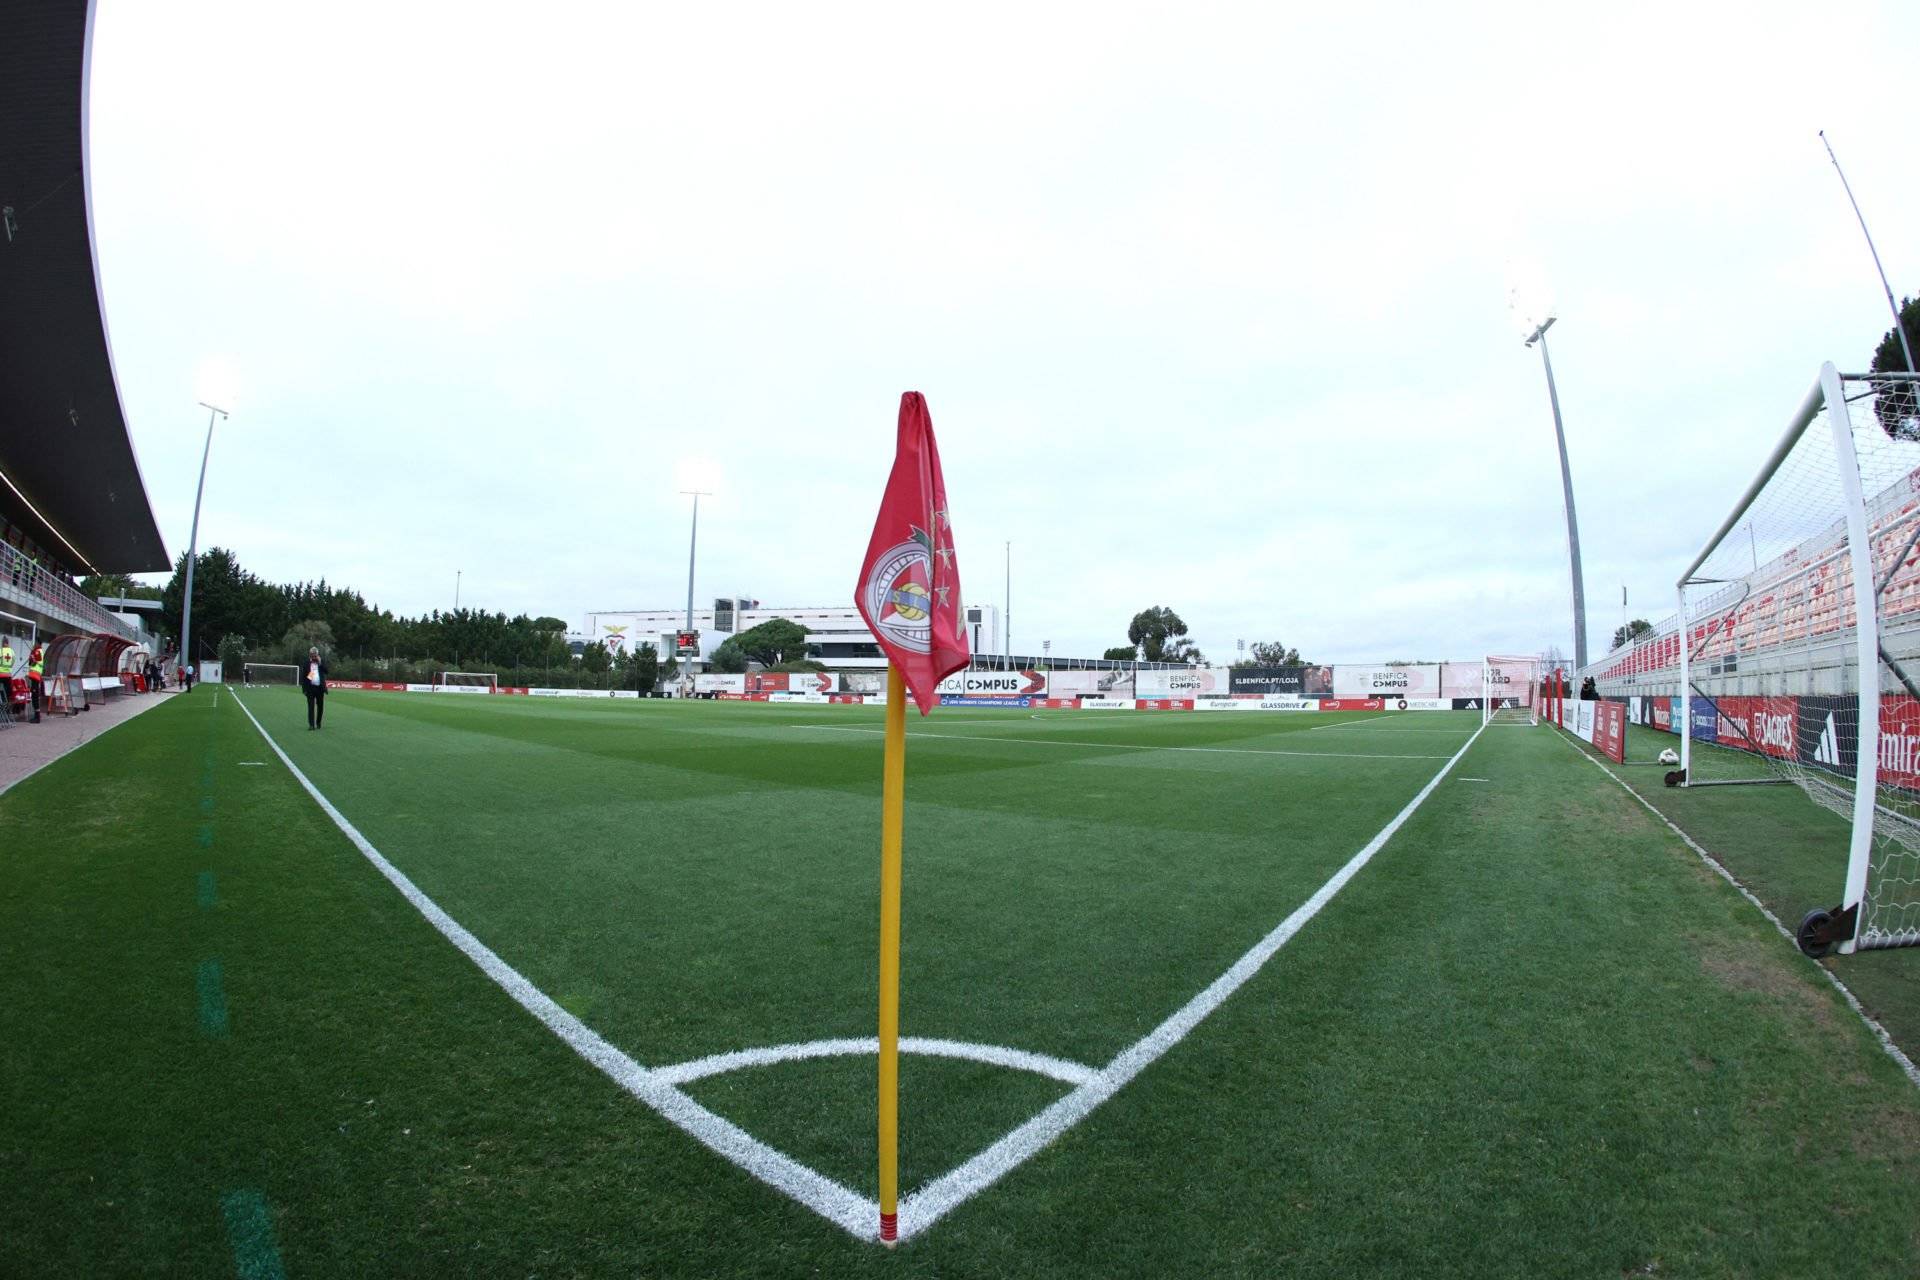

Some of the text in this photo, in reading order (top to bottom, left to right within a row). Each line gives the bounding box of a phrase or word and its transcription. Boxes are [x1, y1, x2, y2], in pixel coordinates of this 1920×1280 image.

[1170, 674, 1201, 682] BENFICA
[1373, 672, 1408, 680] BENFICA
[1235, 677, 1299, 685] SLBENFICA.PT/LOJA
[1717, 711, 1749, 741] Emirates
[1761, 711, 1793, 751] SAGRES
